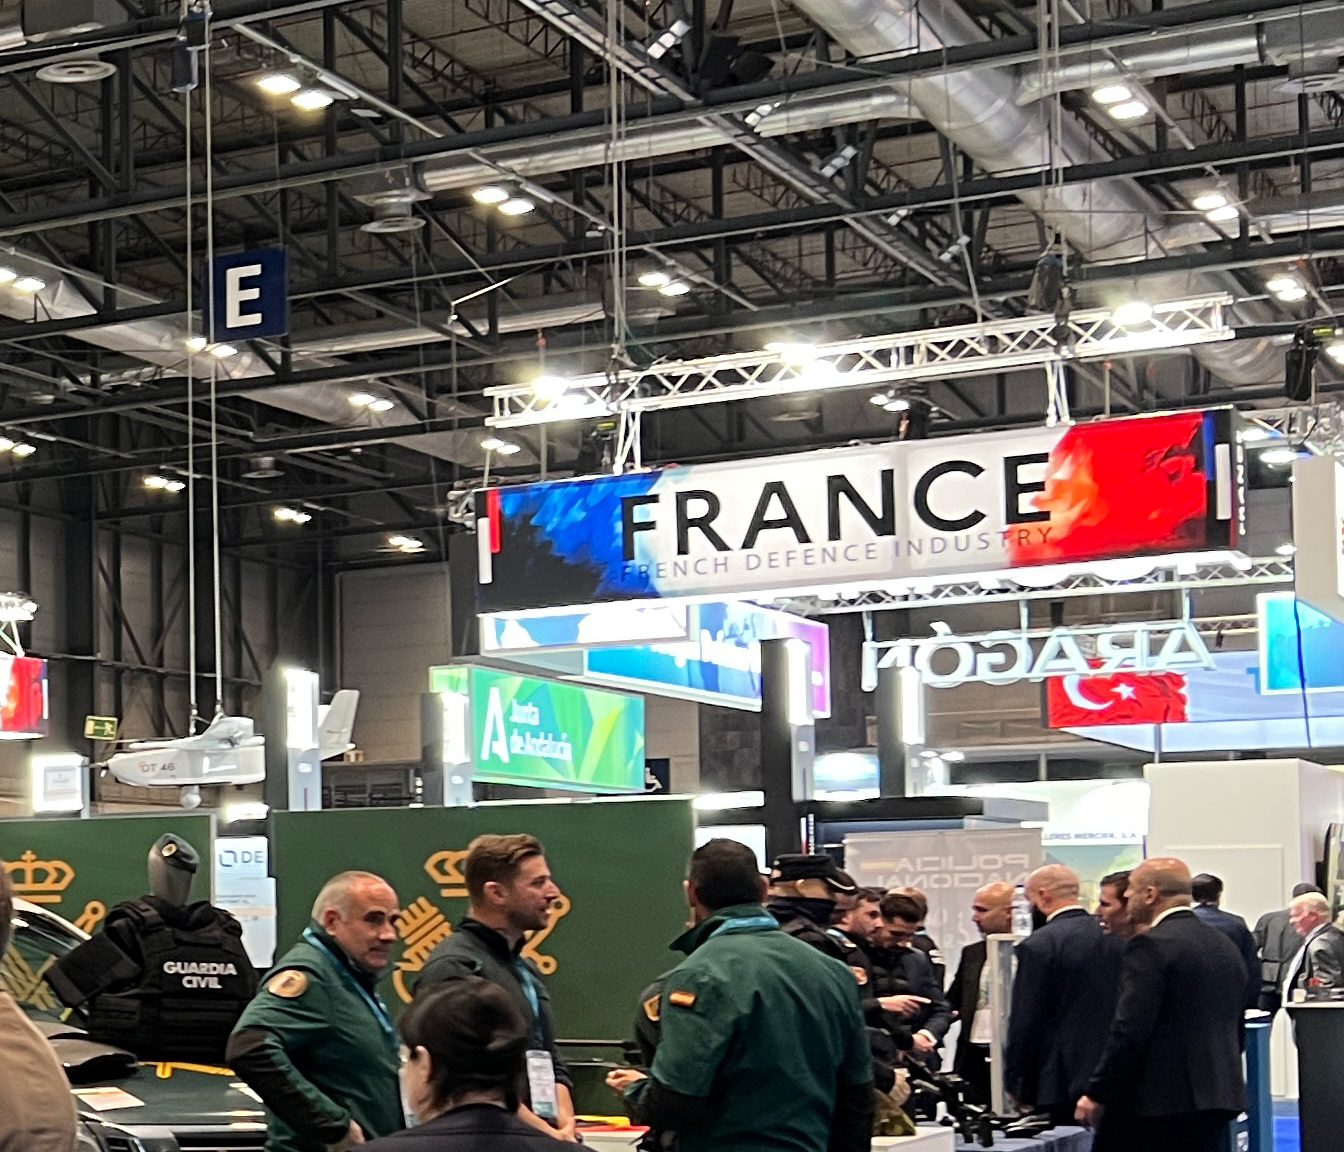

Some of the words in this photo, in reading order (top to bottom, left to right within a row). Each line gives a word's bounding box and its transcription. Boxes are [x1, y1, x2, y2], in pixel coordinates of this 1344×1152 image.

[226, 264, 262, 328] E
[621, 452, 1050, 561] FRANCE
[620, 557, 729, 583] FRENCH
[746, 543, 877, 571] DEFENCE
[894, 526, 1053, 558] INDUSTRY
[164, 961, 238, 976] GUARDIA
[182, 975, 223, 989] CIVIL
